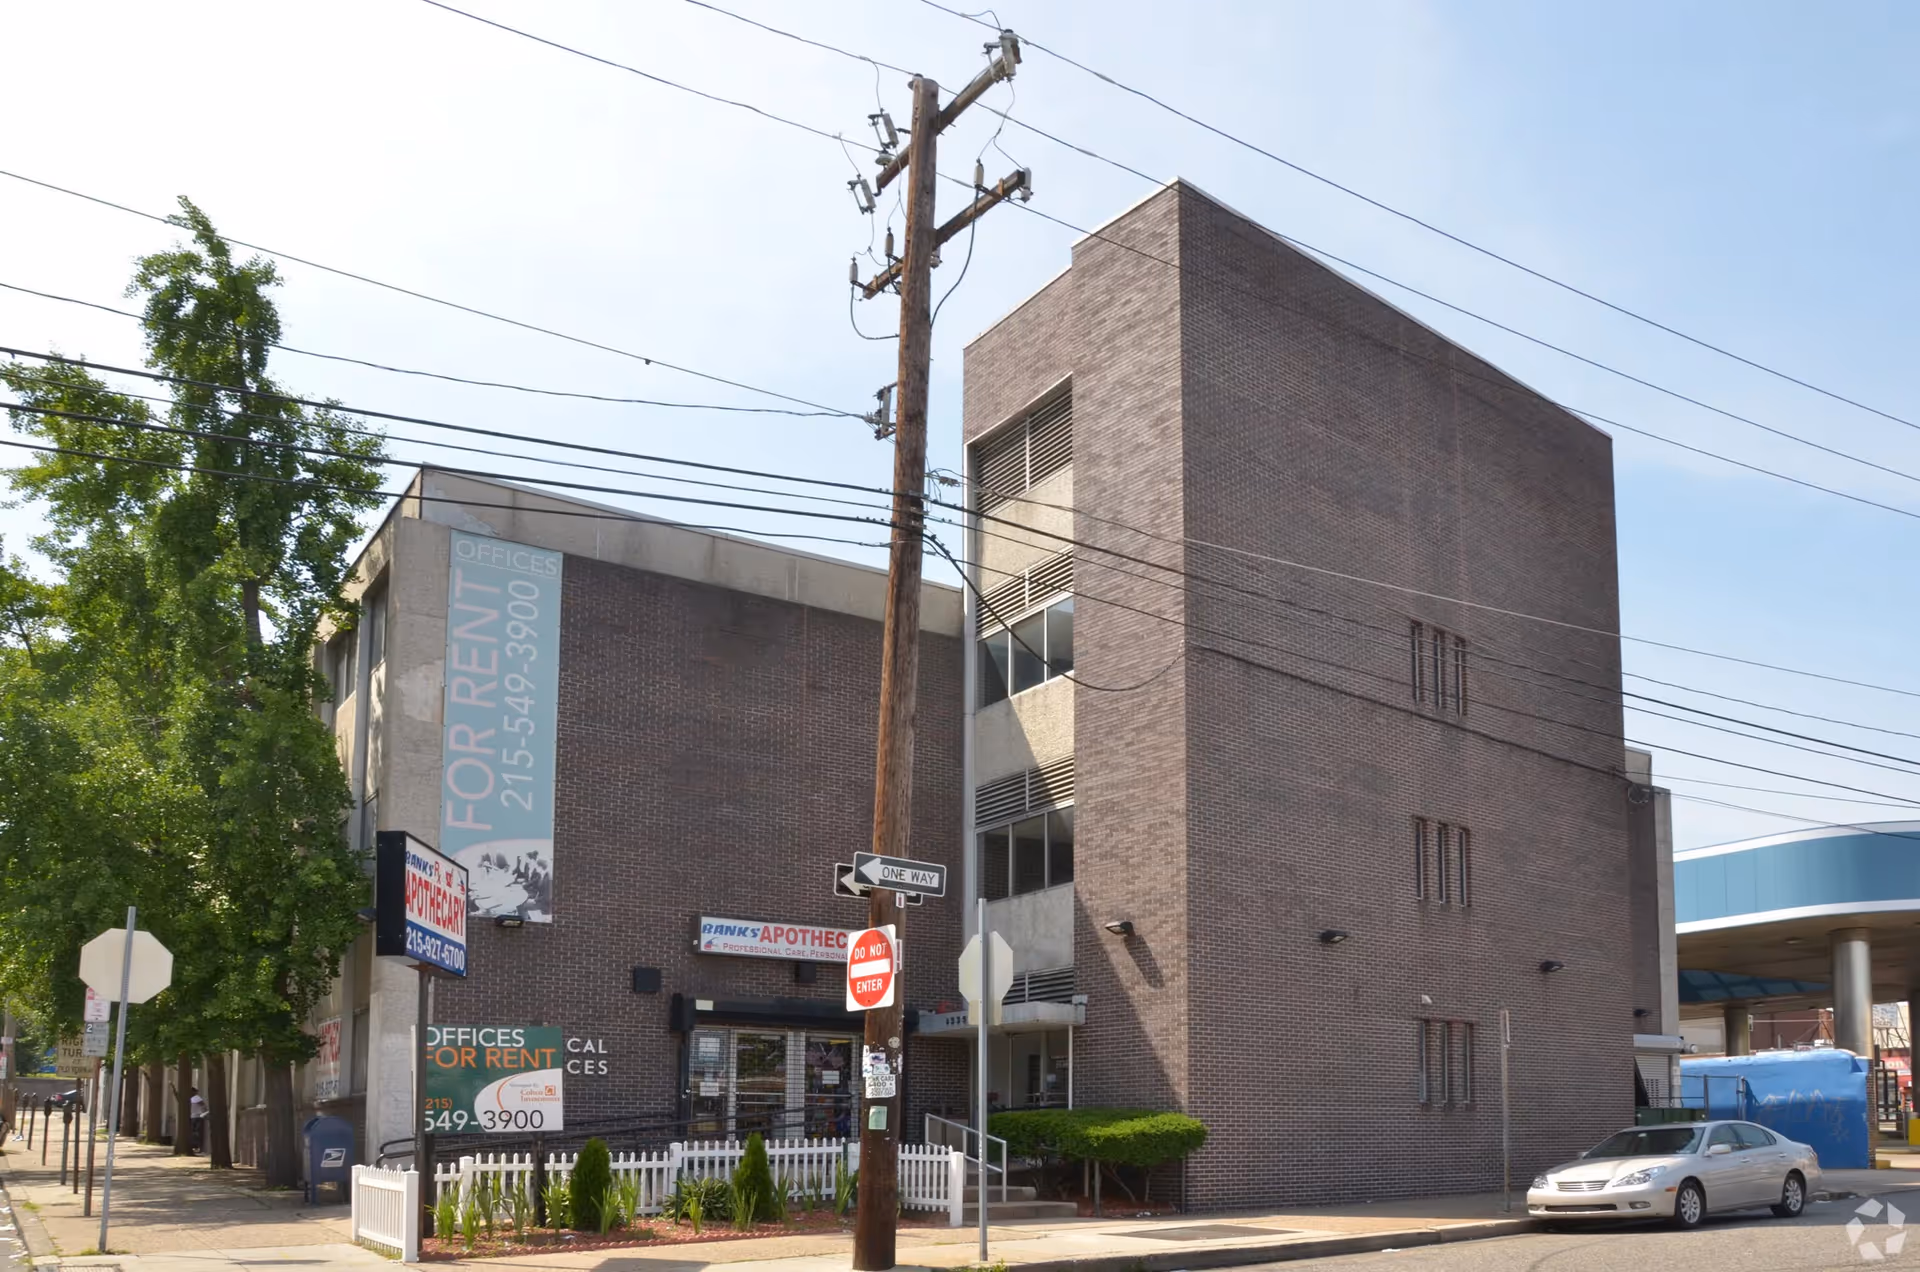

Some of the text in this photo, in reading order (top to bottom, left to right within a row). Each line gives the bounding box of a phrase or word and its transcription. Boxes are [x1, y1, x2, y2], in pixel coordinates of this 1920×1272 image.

[455, 539, 558, 575] OFFICES
[446, 568, 501, 831] FOR RENT
[500, 580, 540, 812] 215-549-3900
[882, 866, 936, 885] ONE WAY
[405, 869, 466, 937] APOTHECARY
[406, 926, 466, 970] 215-927-6700
[723, 943, 782, 956] PROFESSIONAL
[854, 942, 887, 960] DO NOT
[856, 978, 883, 994] ENTER
[86, 1023, 93, 1033] 2
[427, 1026, 525, 1048] OFFICES
[62, 1047, 83, 1058] TUR
[485, 1048, 557, 1070] RENT
[425, 1110, 544, 1132] 549-3900
